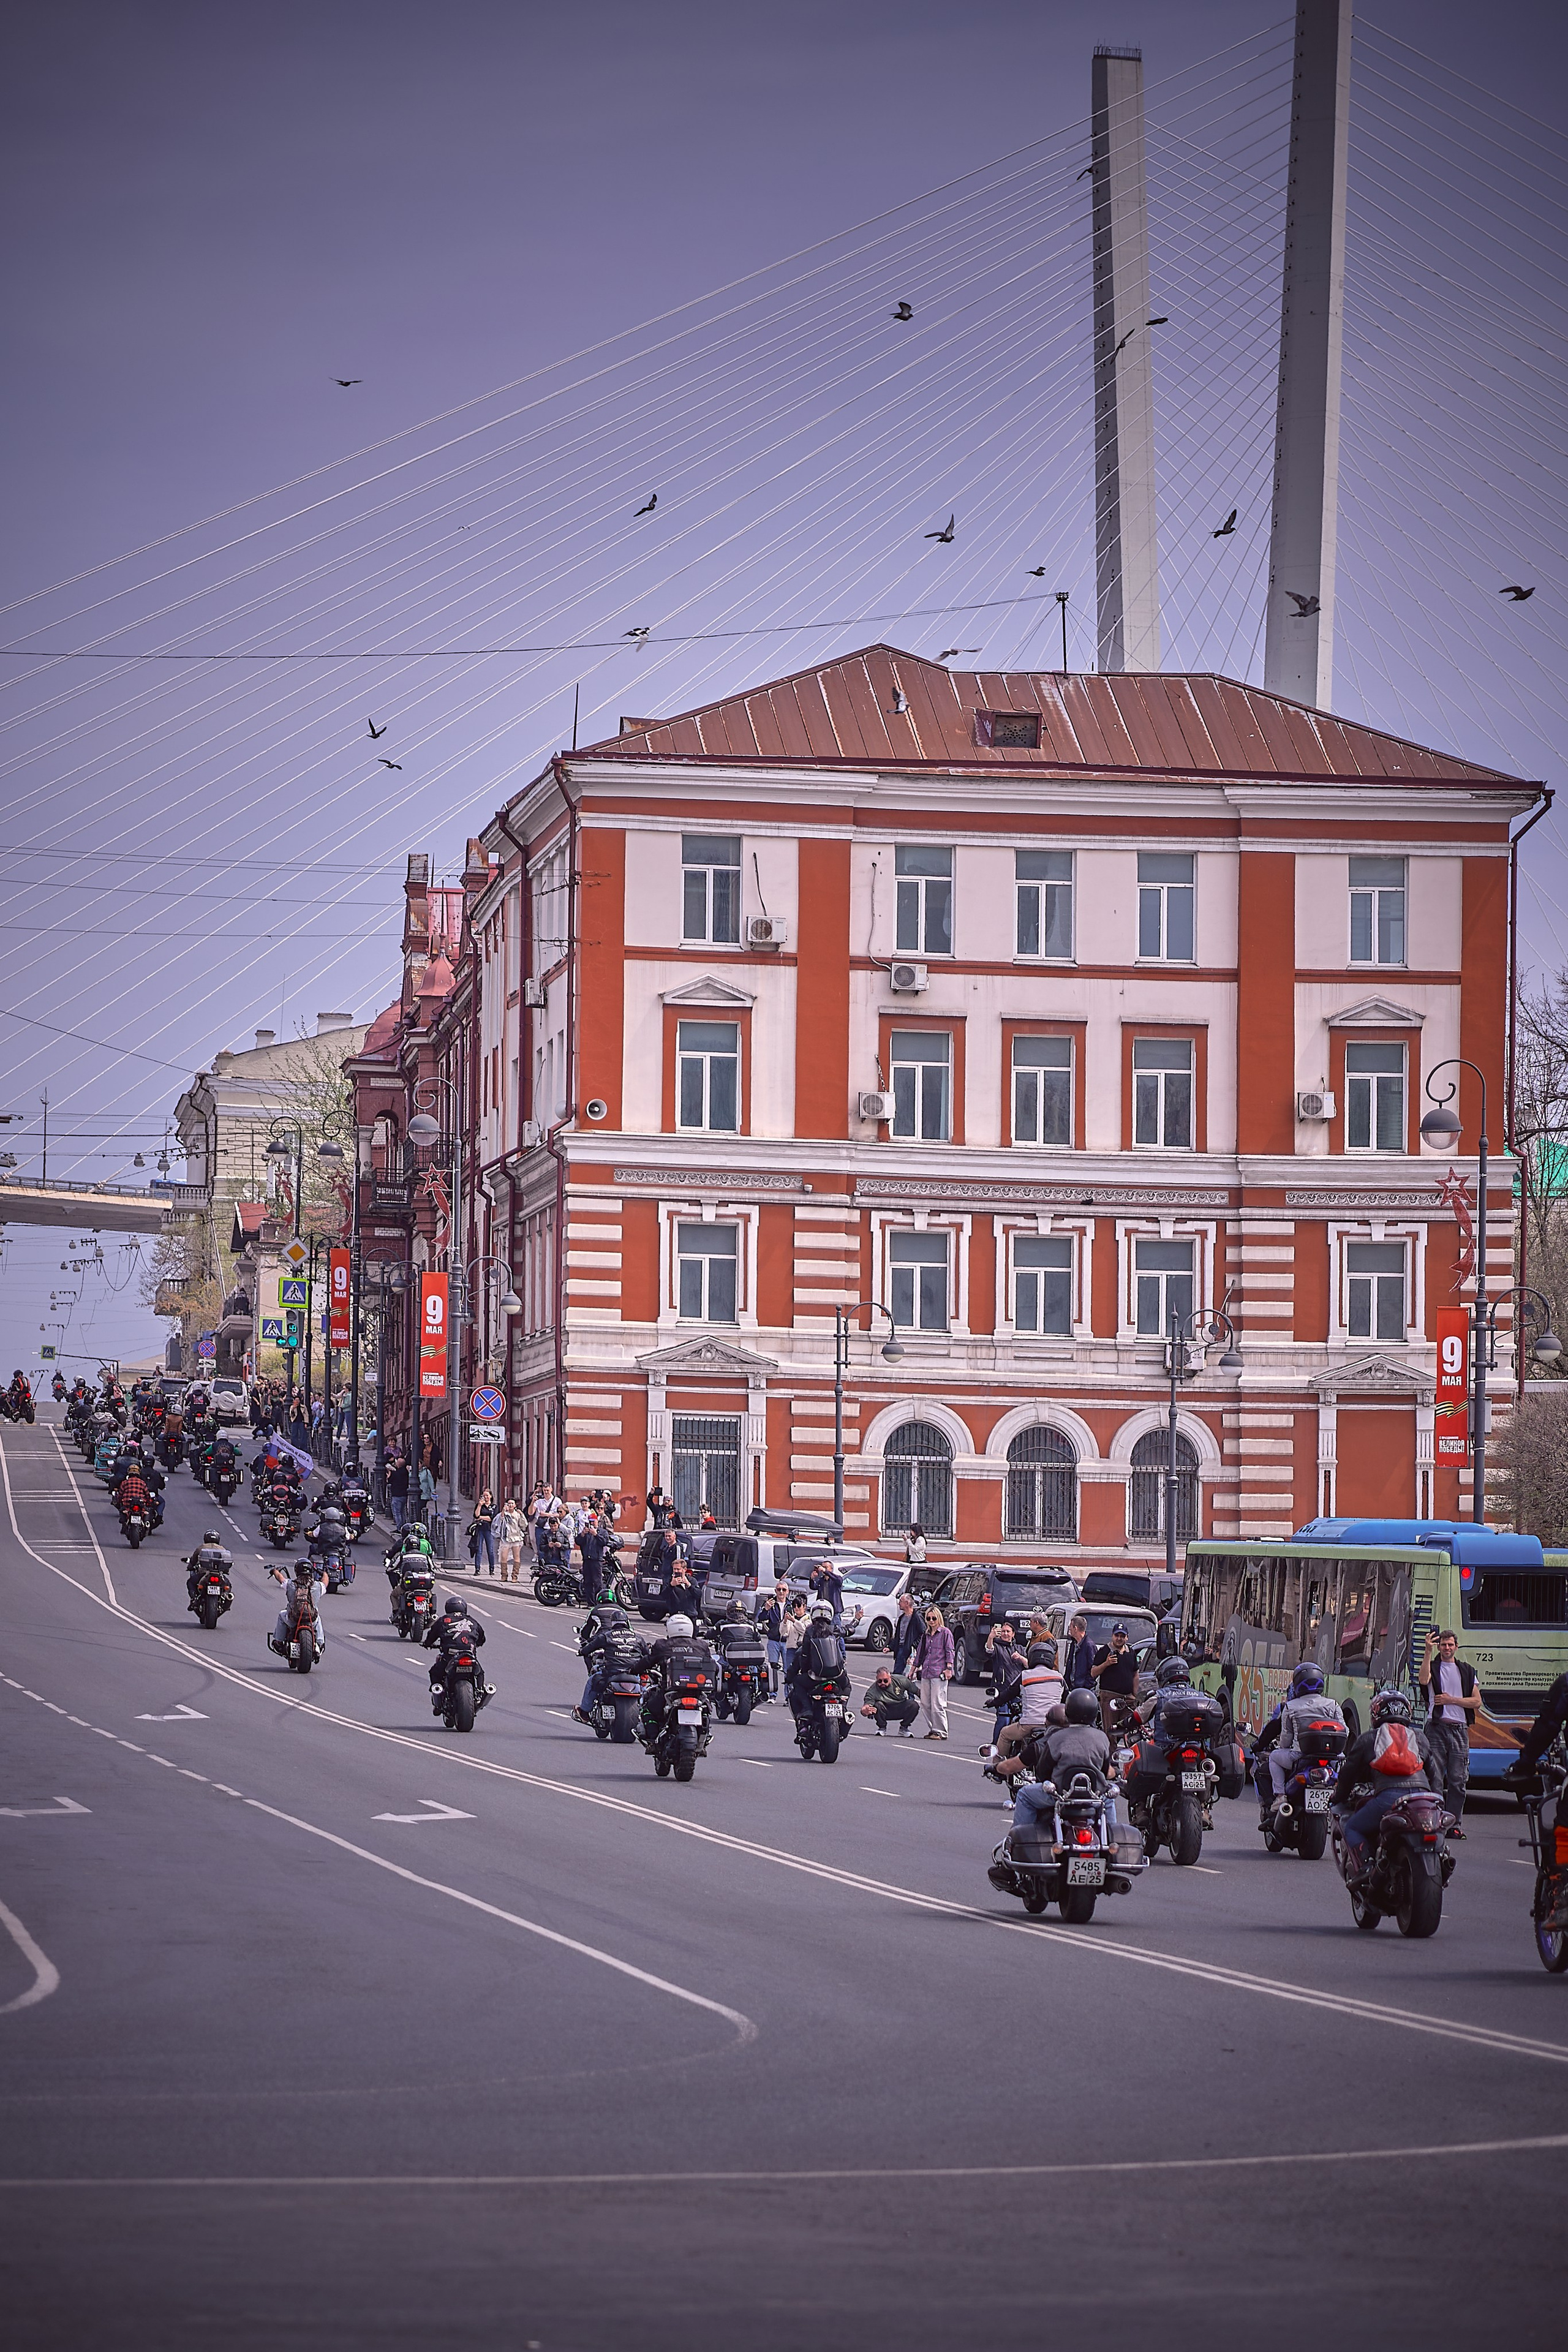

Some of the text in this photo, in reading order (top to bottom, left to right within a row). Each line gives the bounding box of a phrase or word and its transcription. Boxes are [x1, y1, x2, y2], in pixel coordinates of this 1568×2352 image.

[334, 1266, 347, 1290] 9
[426, 1295, 443, 1324] 9
[425, 1325, 443, 1334] МАЯ
[1442, 1336, 1463, 1373] 9
[1442, 1376, 1462, 1386] МАЯ
[1476, 1653, 1493, 1662] 723
[1238, 1638, 1267, 1737] 85
[1074, 1861, 1099, 1871] 5485
[1088, 1875, 1102, 1883] 25
